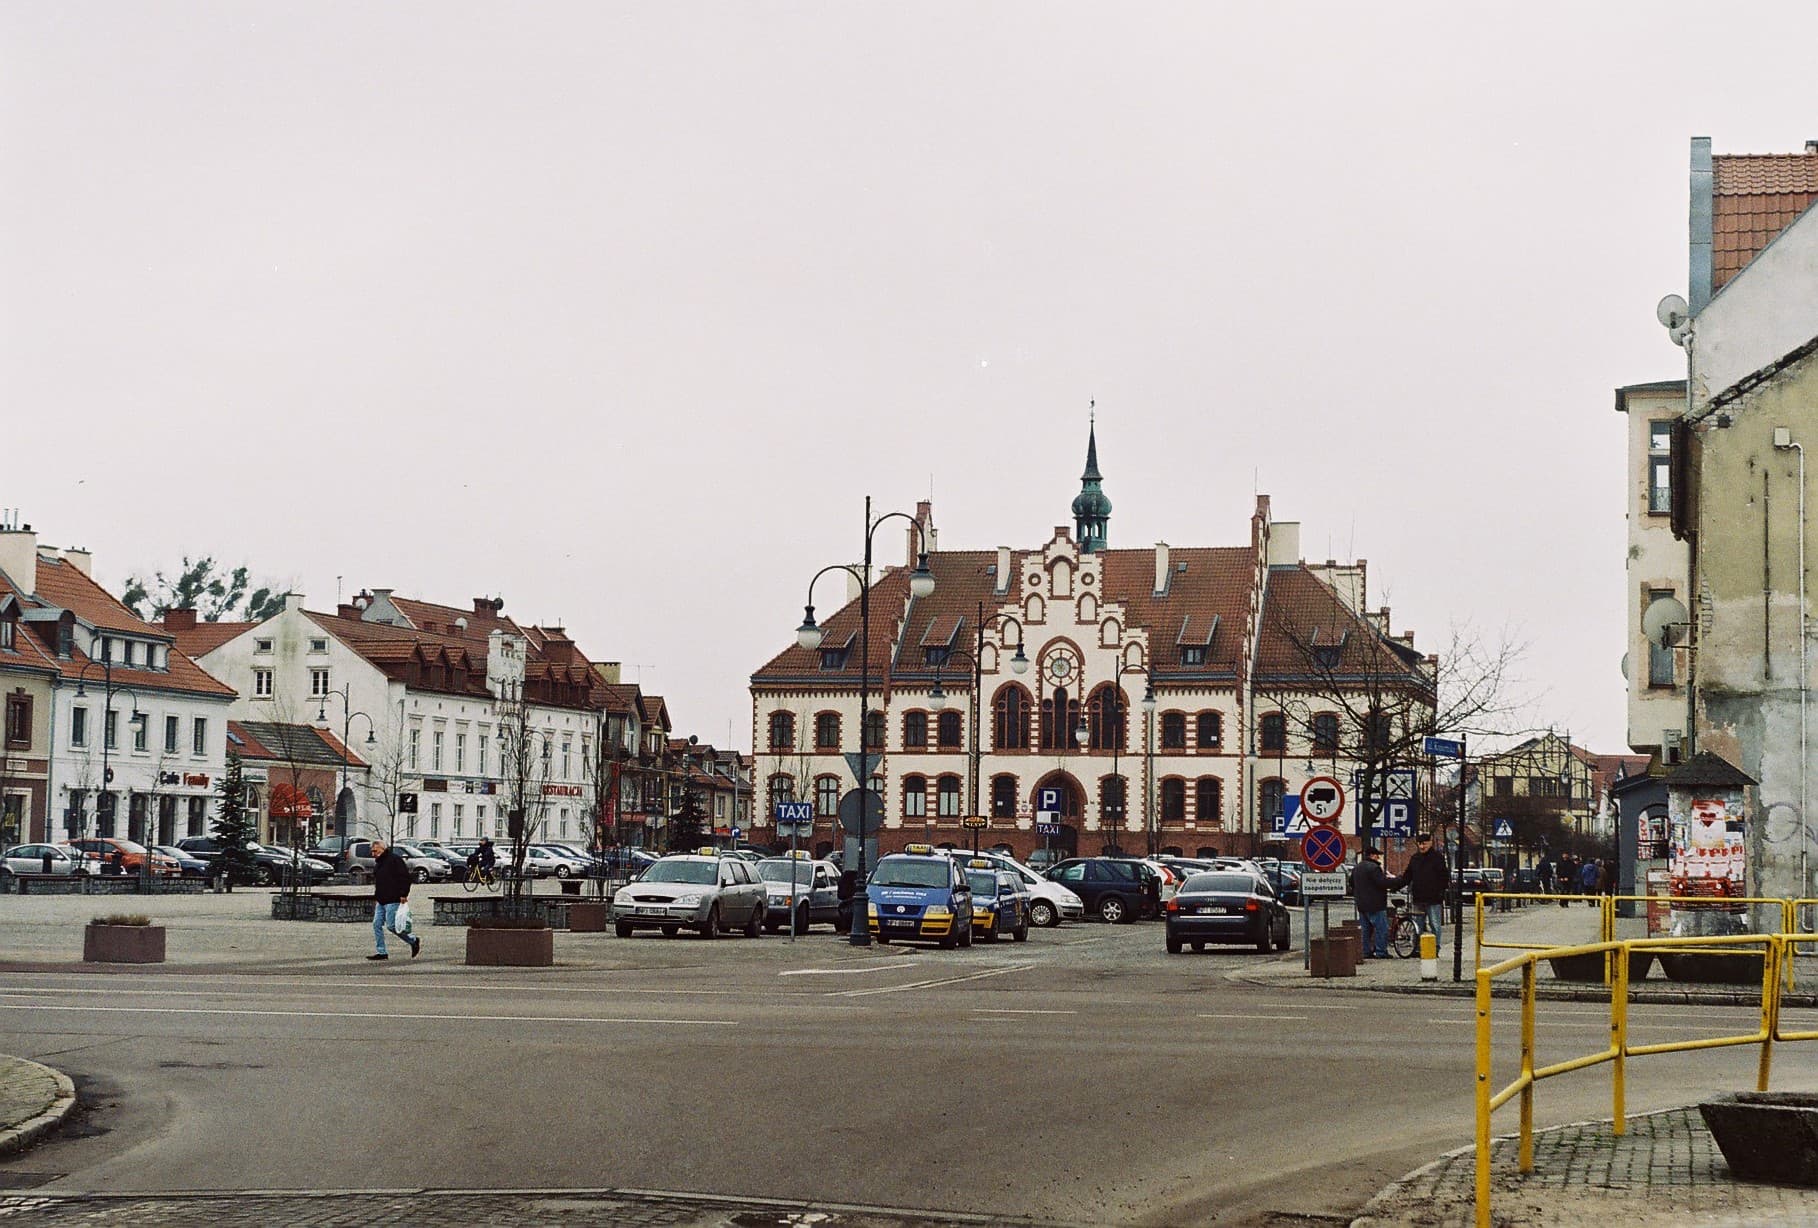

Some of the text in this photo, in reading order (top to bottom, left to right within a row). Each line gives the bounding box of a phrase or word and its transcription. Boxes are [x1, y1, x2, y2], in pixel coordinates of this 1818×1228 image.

[160, 770, 209, 789] Cafe Family
[1043, 790, 1057, 809] P
[778, 804, 810, 819] TAXI
[1390, 803, 1408, 829] P
[1037, 824, 1059, 835] TAXI
[1275, 816, 1285, 831] P
